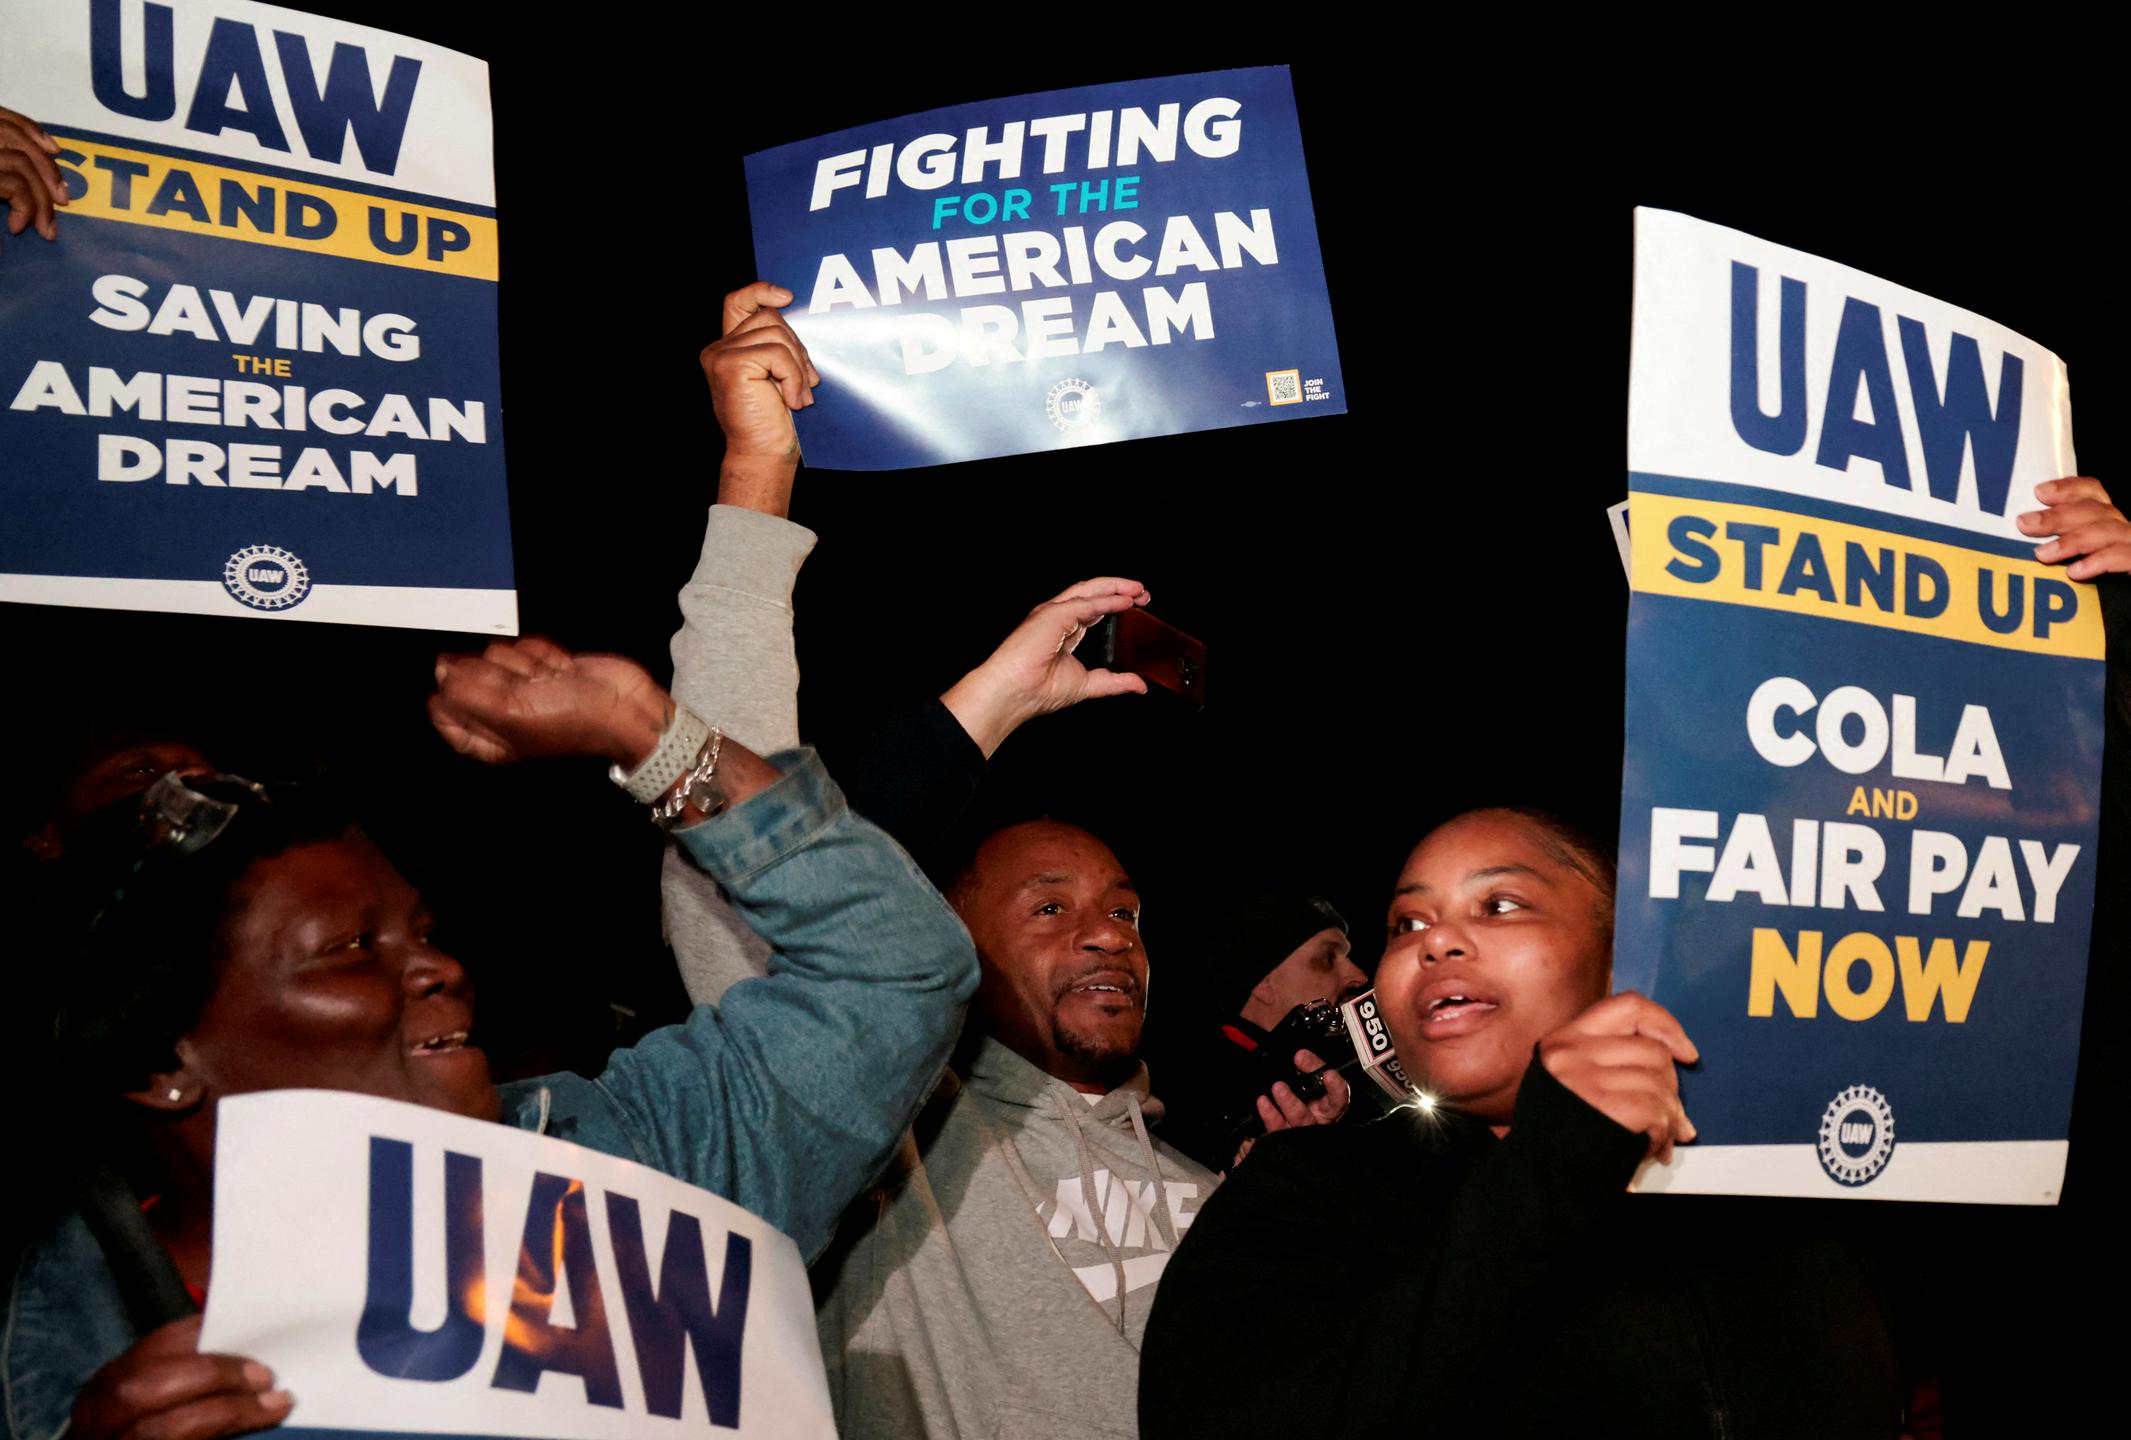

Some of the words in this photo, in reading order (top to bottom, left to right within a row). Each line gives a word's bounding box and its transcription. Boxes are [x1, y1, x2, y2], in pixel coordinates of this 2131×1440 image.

[90, 0, 422, 177] UAW
[809, 97, 1242, 212] FIGHTING
[55, 147, 338, 241] STAND
[367, 206, 471, 263] UP
[932, 188, 1032, 230] FOR
[1049, 176, 1141, 216] THE
[807, 208, 1279, 314] AMERICAN
[89, 274, 421, 361] SAVING
[901, 281, 1215, 376] DREAM
[10, 360, 487, 444] AMERICAN
[232, 354, 293, 378] THE
[1304, 378, 1324, 387] JOIN
[1305, 386, 1321, 394] THE
[1306, 392, 1330, 402] FIGHT
[1730, 259, 2025, 518] UAW
[98, 434, 418, 497] DREAM
[248, 568, 285, 584] UAW
[1664, 515, 1951, 620] STAND
[1977, 567, 2079, 640] UP
[1746, 676, 2013, 790] COLA
[1846, 786, 1919, 821] AND
[1649, 806, 1885, 912] FAIR
[1907, 829, 2082, 924] PAY
[1748, 927, 1991, 1024] NOW
[1360, 1001, 1388, 1051] 950
[1841, 1122, 1874, 1145] UAW
[1047, 1169, 1198, 1252] NIKE
[356, 1135, 753, 1430] UAW
